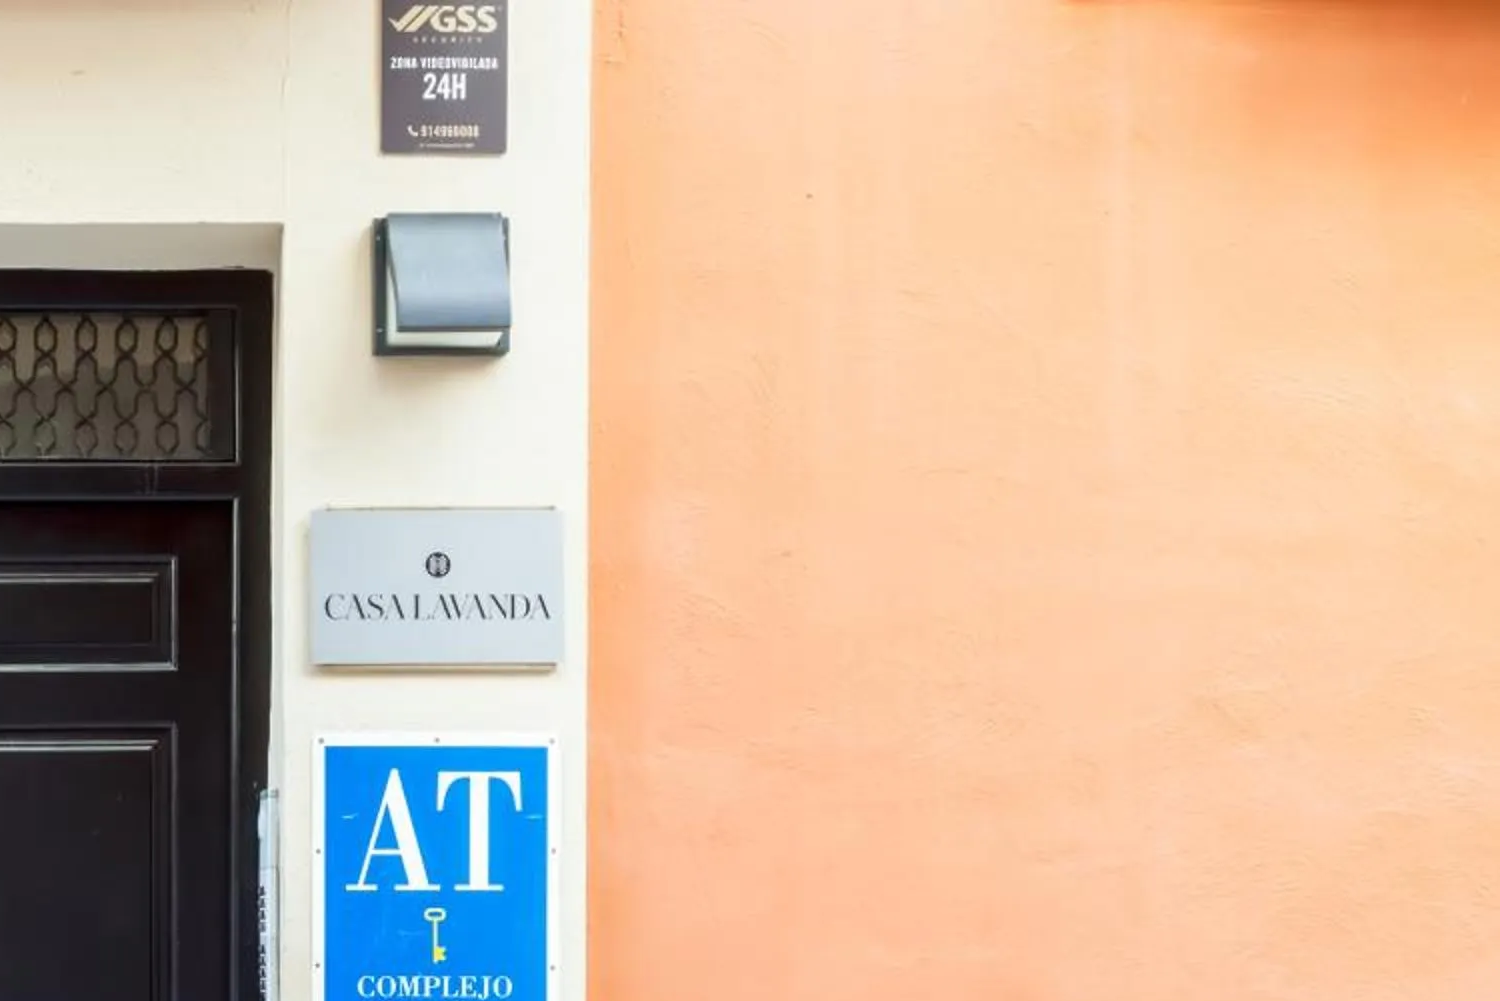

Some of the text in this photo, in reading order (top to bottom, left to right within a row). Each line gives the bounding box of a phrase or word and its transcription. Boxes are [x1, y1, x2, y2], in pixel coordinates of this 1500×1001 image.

[422, 73, 467, 100] 24H
[324, 594, 551, 621] CASA LAVANDA
[345, 768, 523, 892] AT
[357, 975, 514, 1000] COMPLEJO
